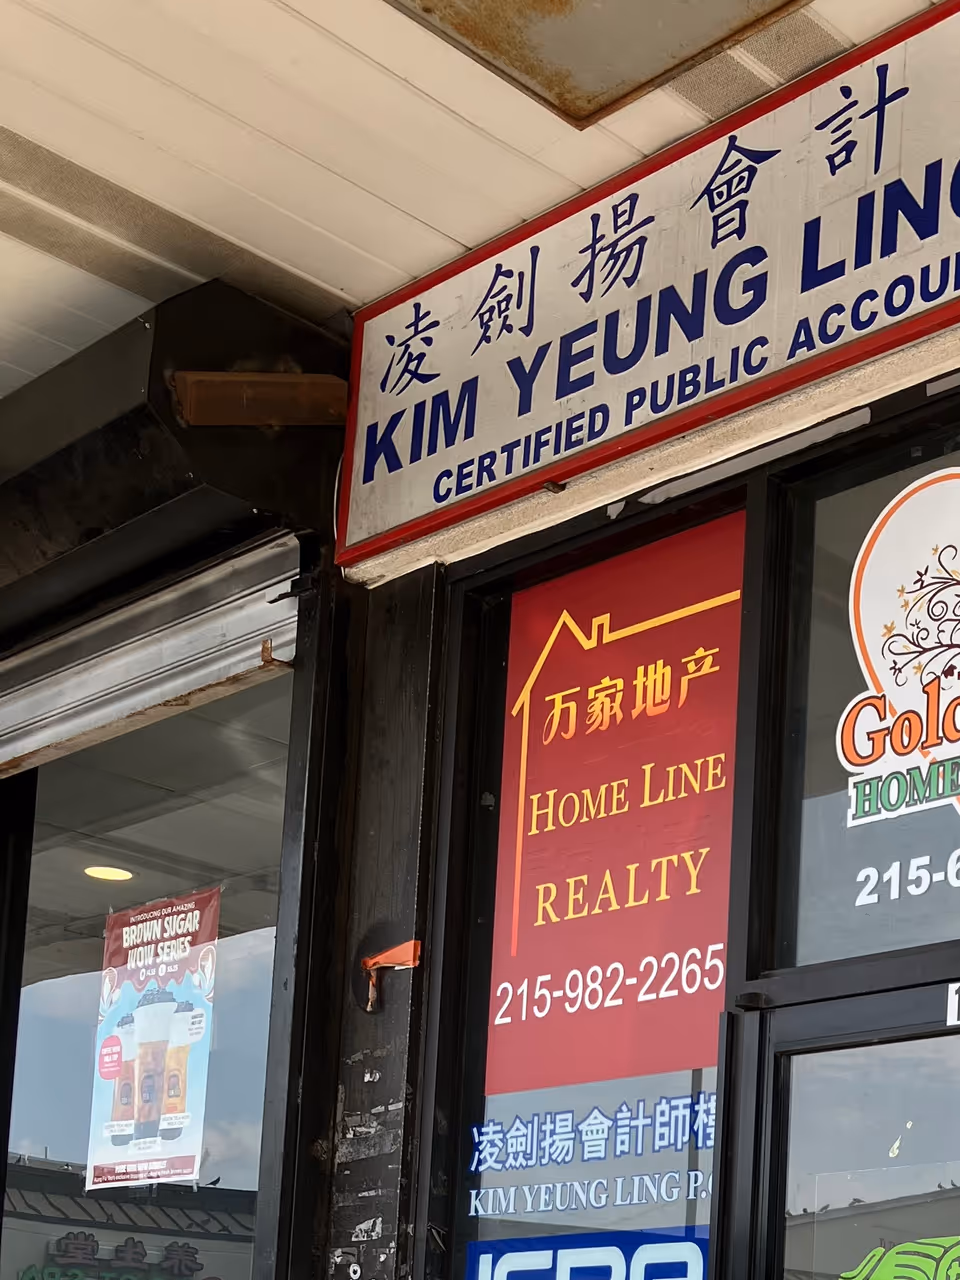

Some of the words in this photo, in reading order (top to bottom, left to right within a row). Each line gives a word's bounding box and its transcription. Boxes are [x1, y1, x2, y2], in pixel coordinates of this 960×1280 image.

[362, 376, 479, 484] KIM
[507, 245, 769, 418] YEUNG
[433, 403, 609, 503] CERTIFIED
[624, 336, 769, 426] PUBLIC
[542, 646, 721, 746] 万家地产
[528, 778, 630, 836] HOME
[642, 753, 727, 809] LINE
[130, 908, 160, 923] INTRODUCING
[172, 901, 196, 913] AMAZING
[533, 847, 711, 927] REALTY
[123, 918, 162, 948] BROWN
[163, 910, 200, 939] SUGAR
[127, 944, 156, 970] WOW
[156, 936, 192, 962] SERIES
[494, 943, 725, 1025] 215-982-2265
[468, 1185, 517, 1217] KIM
[523, 1178, 608, 1214] YEUNG
[614, 1172, 682, 1206] LING
